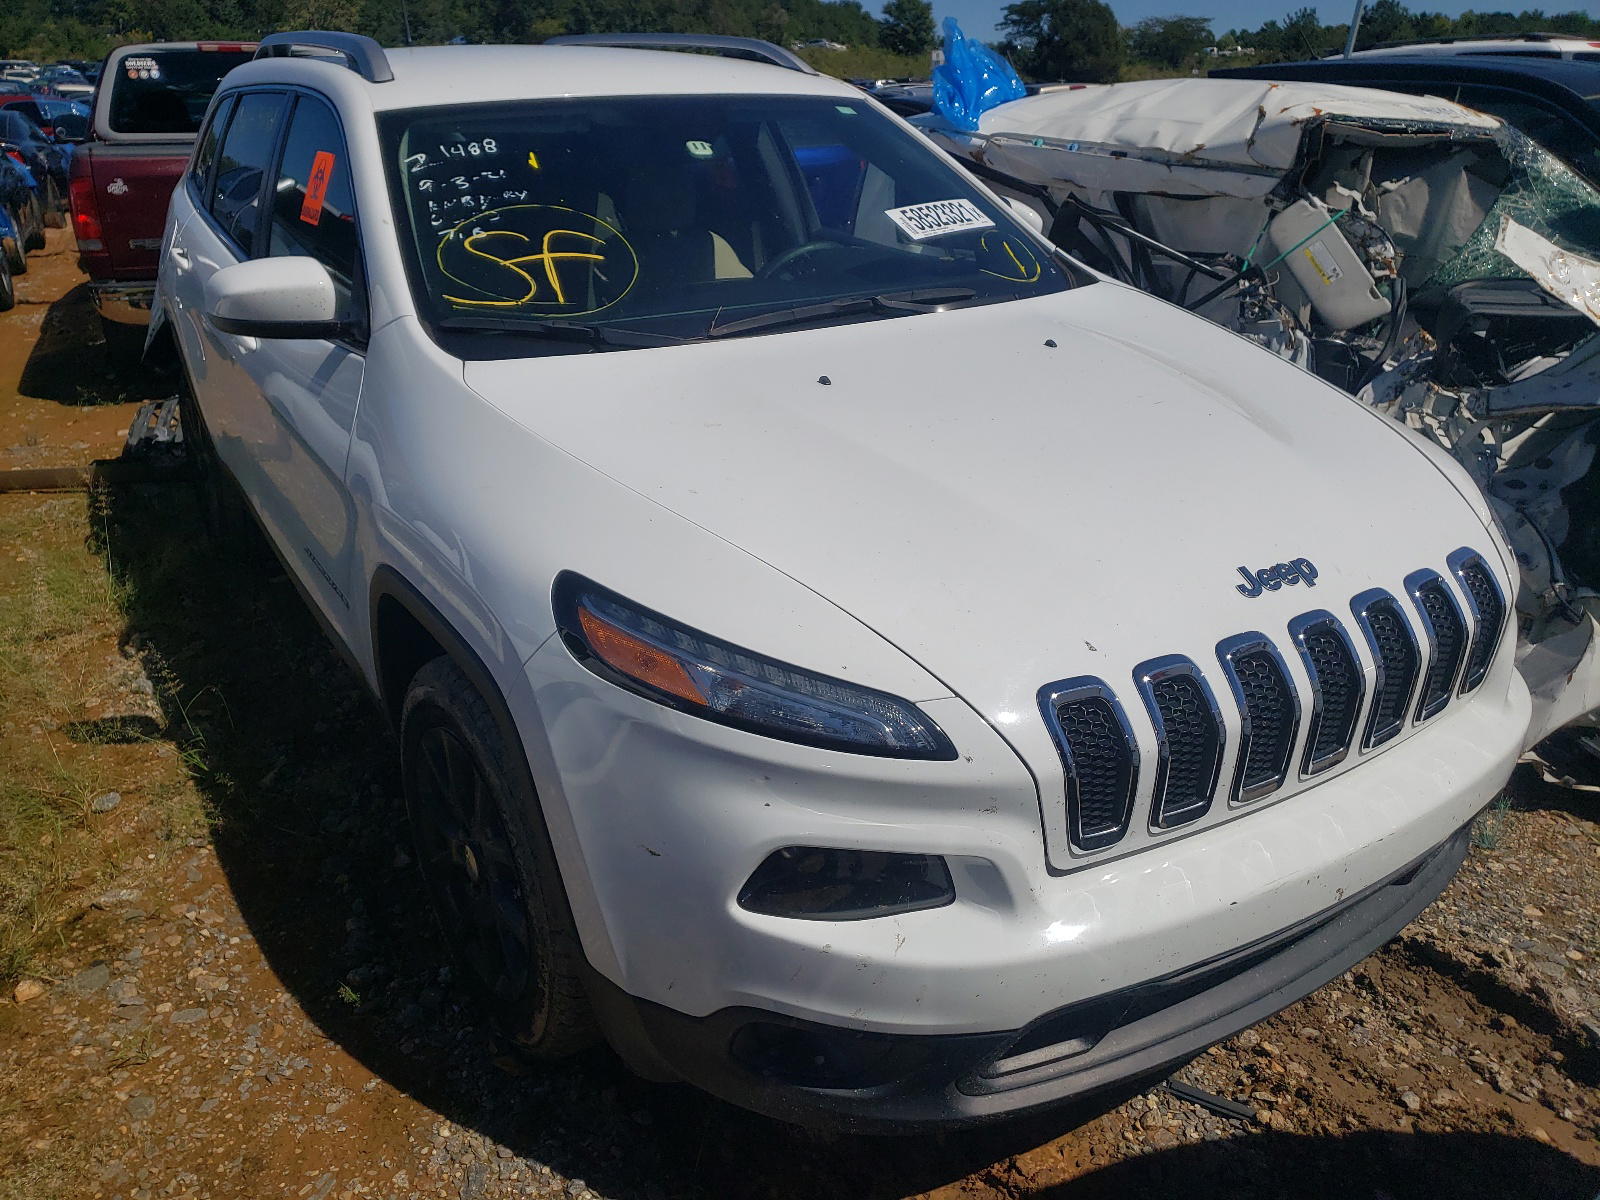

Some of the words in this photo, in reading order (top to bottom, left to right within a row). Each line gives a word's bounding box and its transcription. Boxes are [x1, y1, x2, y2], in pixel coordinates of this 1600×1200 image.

[439, 138, 498, 158] 1488
[900, 201, 980, 231] 58523321
[1235, 557, 1319, 598] Jeep
